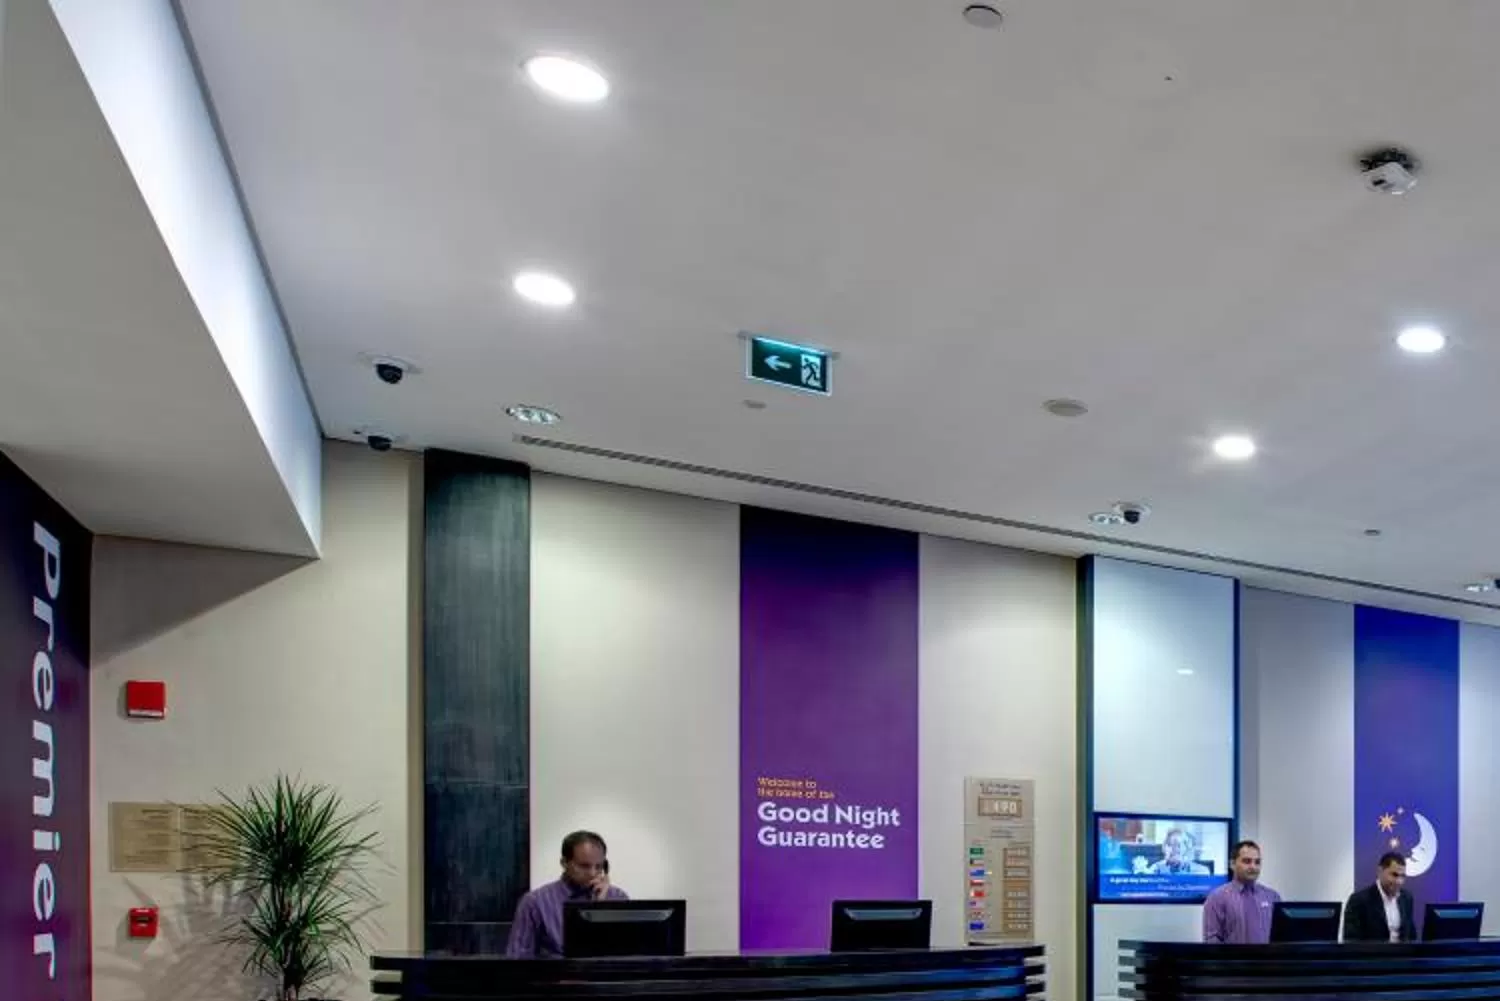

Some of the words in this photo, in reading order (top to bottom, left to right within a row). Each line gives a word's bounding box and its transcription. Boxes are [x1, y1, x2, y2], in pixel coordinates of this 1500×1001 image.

[32, 520, 61, 979] Premier
[805, 779, 817, 789] to
[757, 801, 829, 823] Good
[835, 803, 901, 830] Night
[757, 825, 886, 849] Guarantee
